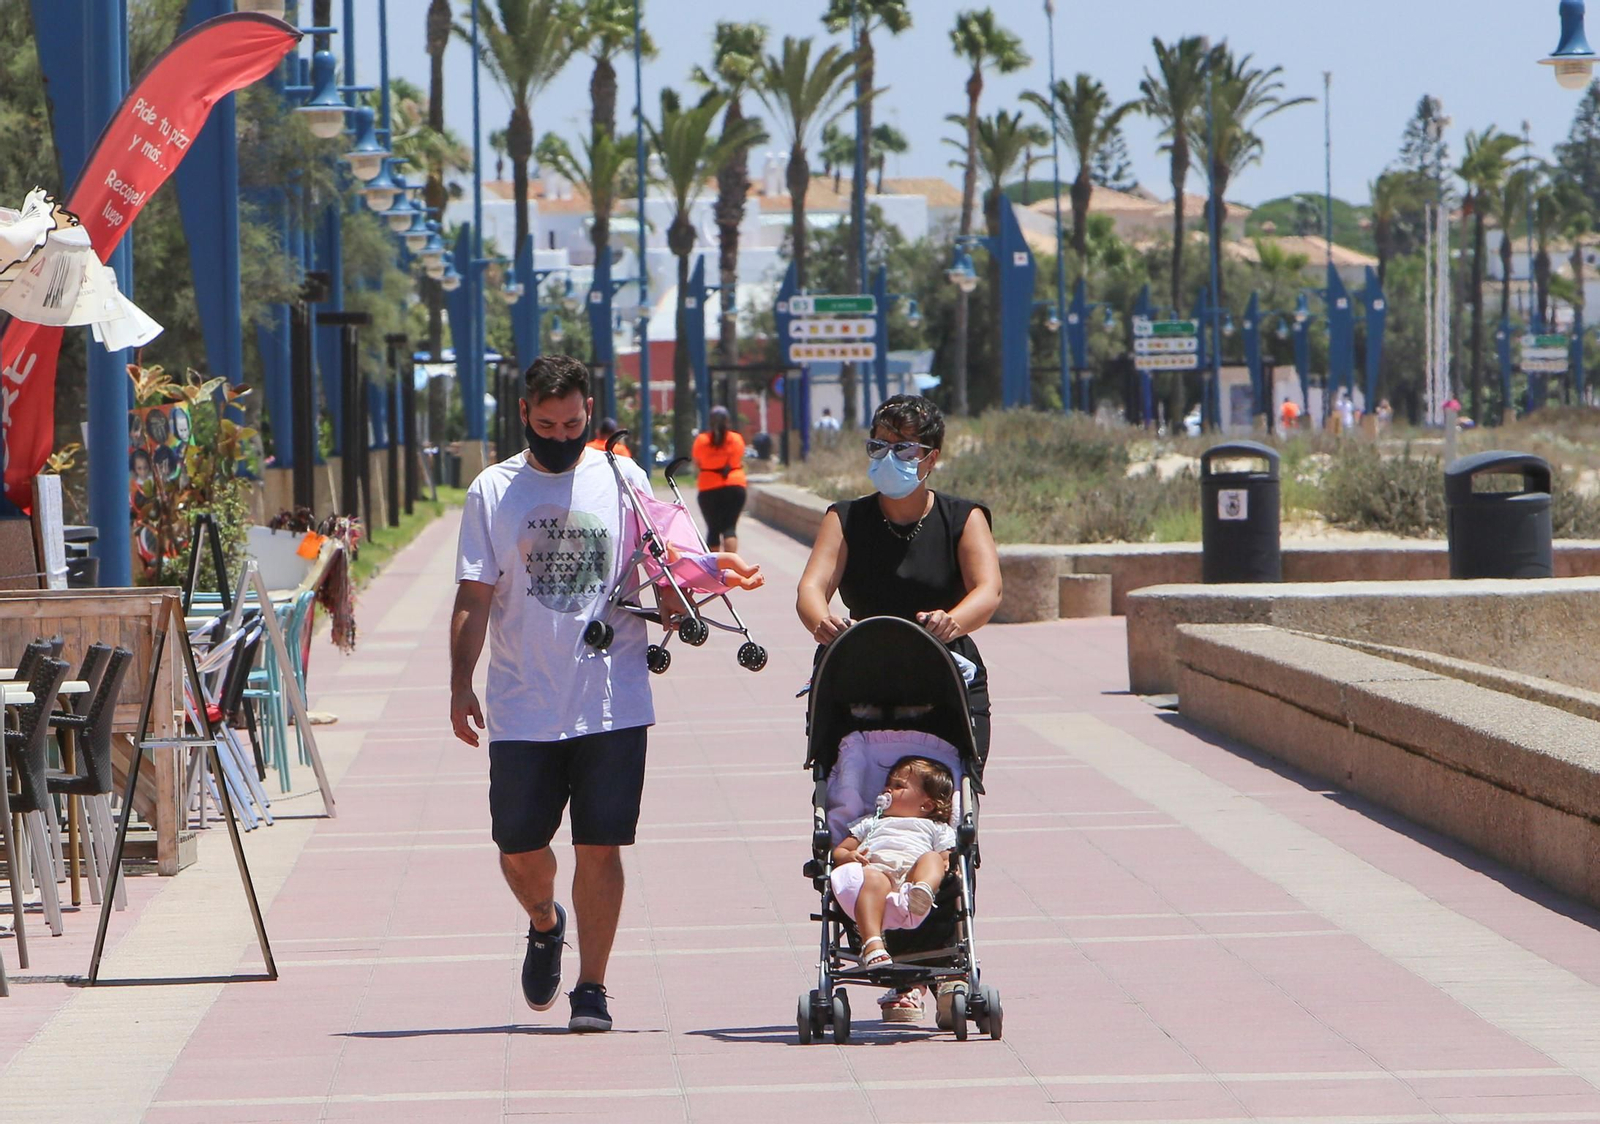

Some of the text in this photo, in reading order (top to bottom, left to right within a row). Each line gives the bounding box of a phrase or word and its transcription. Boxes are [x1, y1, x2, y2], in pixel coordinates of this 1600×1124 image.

[131, 98, 157, 125] Pide
[158, 117, 171, 136] tu
[104, 168, 146, 207] Recógel
[102, 199, 123, 227] luego
